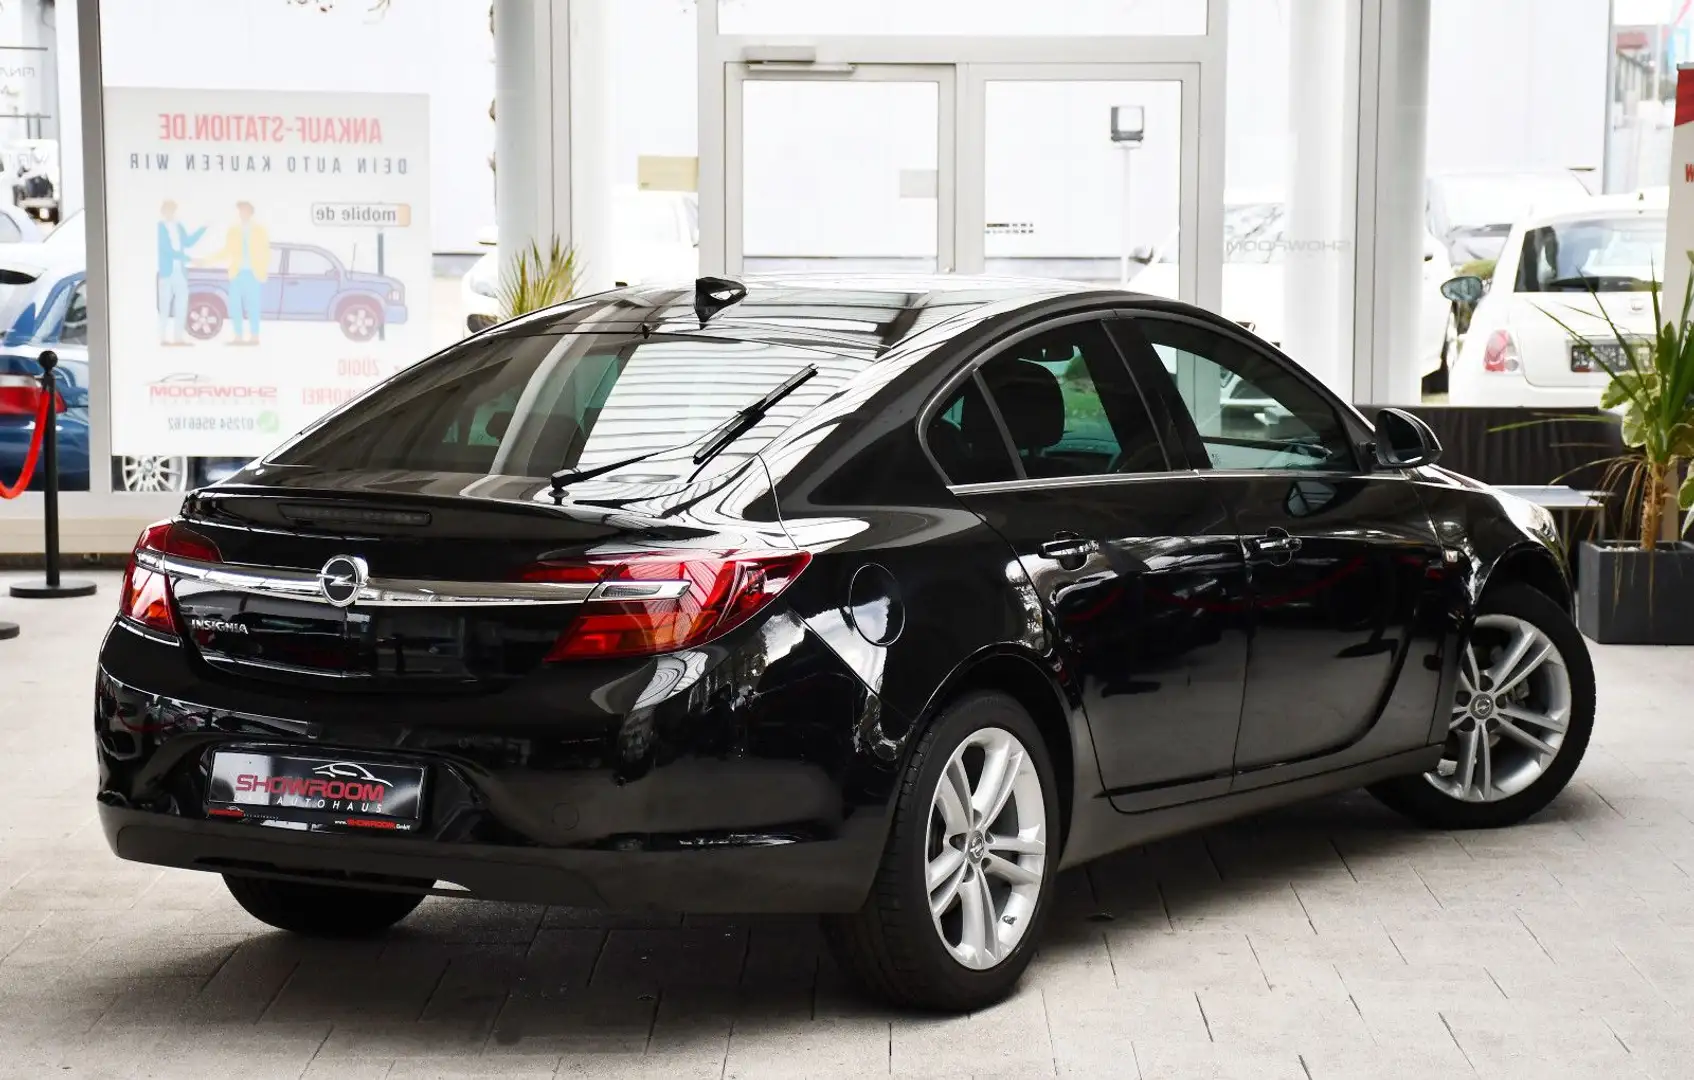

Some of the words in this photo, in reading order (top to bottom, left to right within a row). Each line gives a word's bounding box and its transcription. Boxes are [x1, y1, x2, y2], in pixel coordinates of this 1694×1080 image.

[191, 619, 249, 634] INSIGNIA
[235, 773, 385, 802] SHOWROOM
[276, 796, 384, 814] AUTOHAUS
